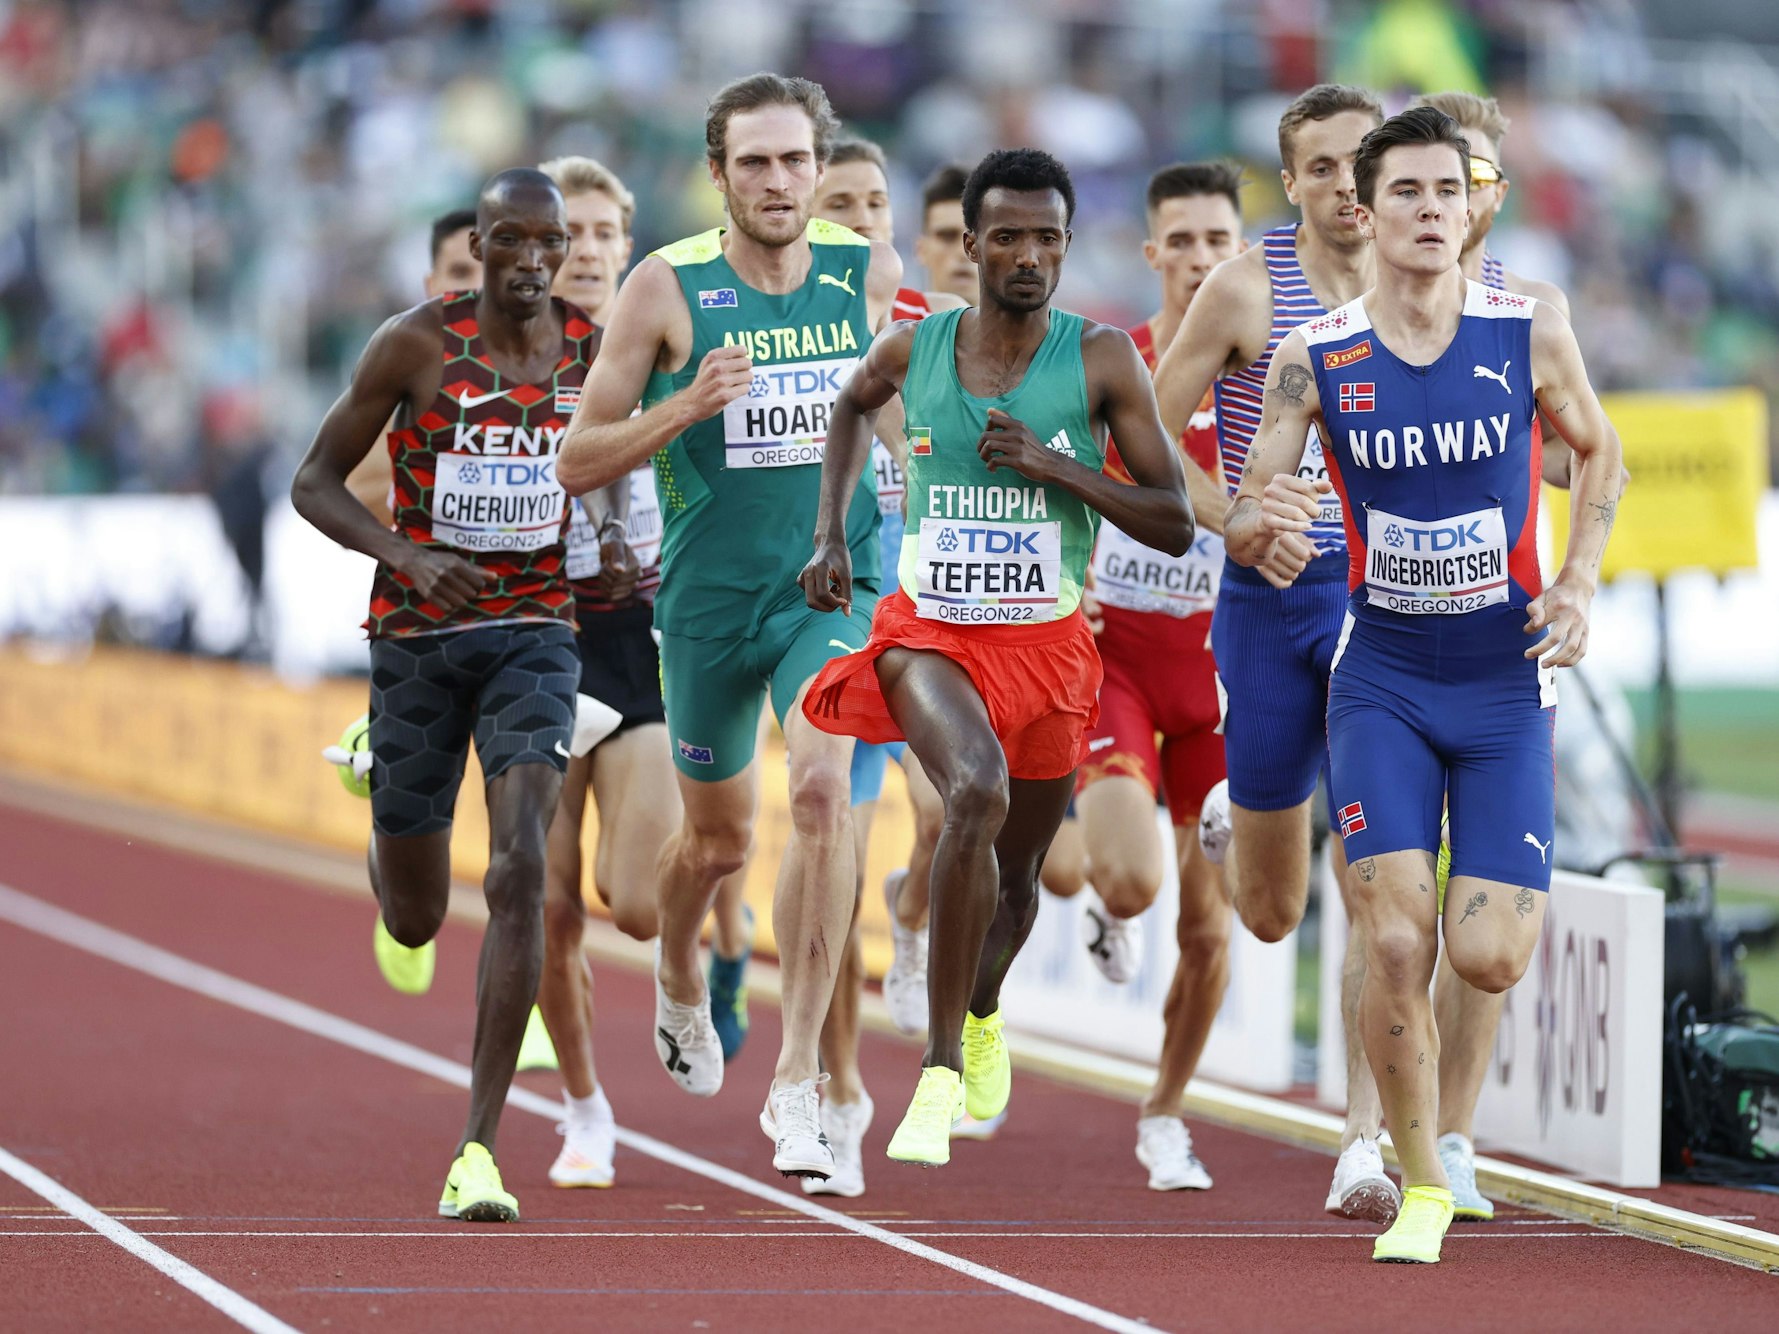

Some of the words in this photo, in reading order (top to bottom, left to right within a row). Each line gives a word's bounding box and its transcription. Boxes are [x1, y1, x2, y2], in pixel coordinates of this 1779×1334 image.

[723, 320, 858, 361] AUSTRALIA
[1341, 346, 1369, 362] EXTRA
[769, 367, 842, 396] TDK
[453, 423, 567, 456] KENY
[752, 446, 825, 465] OREGON
[1349, 412, 1511, 470] NORWAY
[483, 461, 554, 486] TDK
[441, 489, 561, 524] CHERUIYOT
[928, 484, 1048, 520] ETHIOPIA
[455, 531, 544, 548] OREGON22
[958, 528, 1041, 554] TDK
[1404, 519, 1486, 552] TDK
[928, 560, 1046, 593] TEFERA
[1104, 552, 1212, 594] GARCÍA
[1371, 547, 1502, 587] INGEBRIGTSEN
[938, 604, 1034, 622] OREGON22
[1387, 594, 1487, 613] OREGON22
